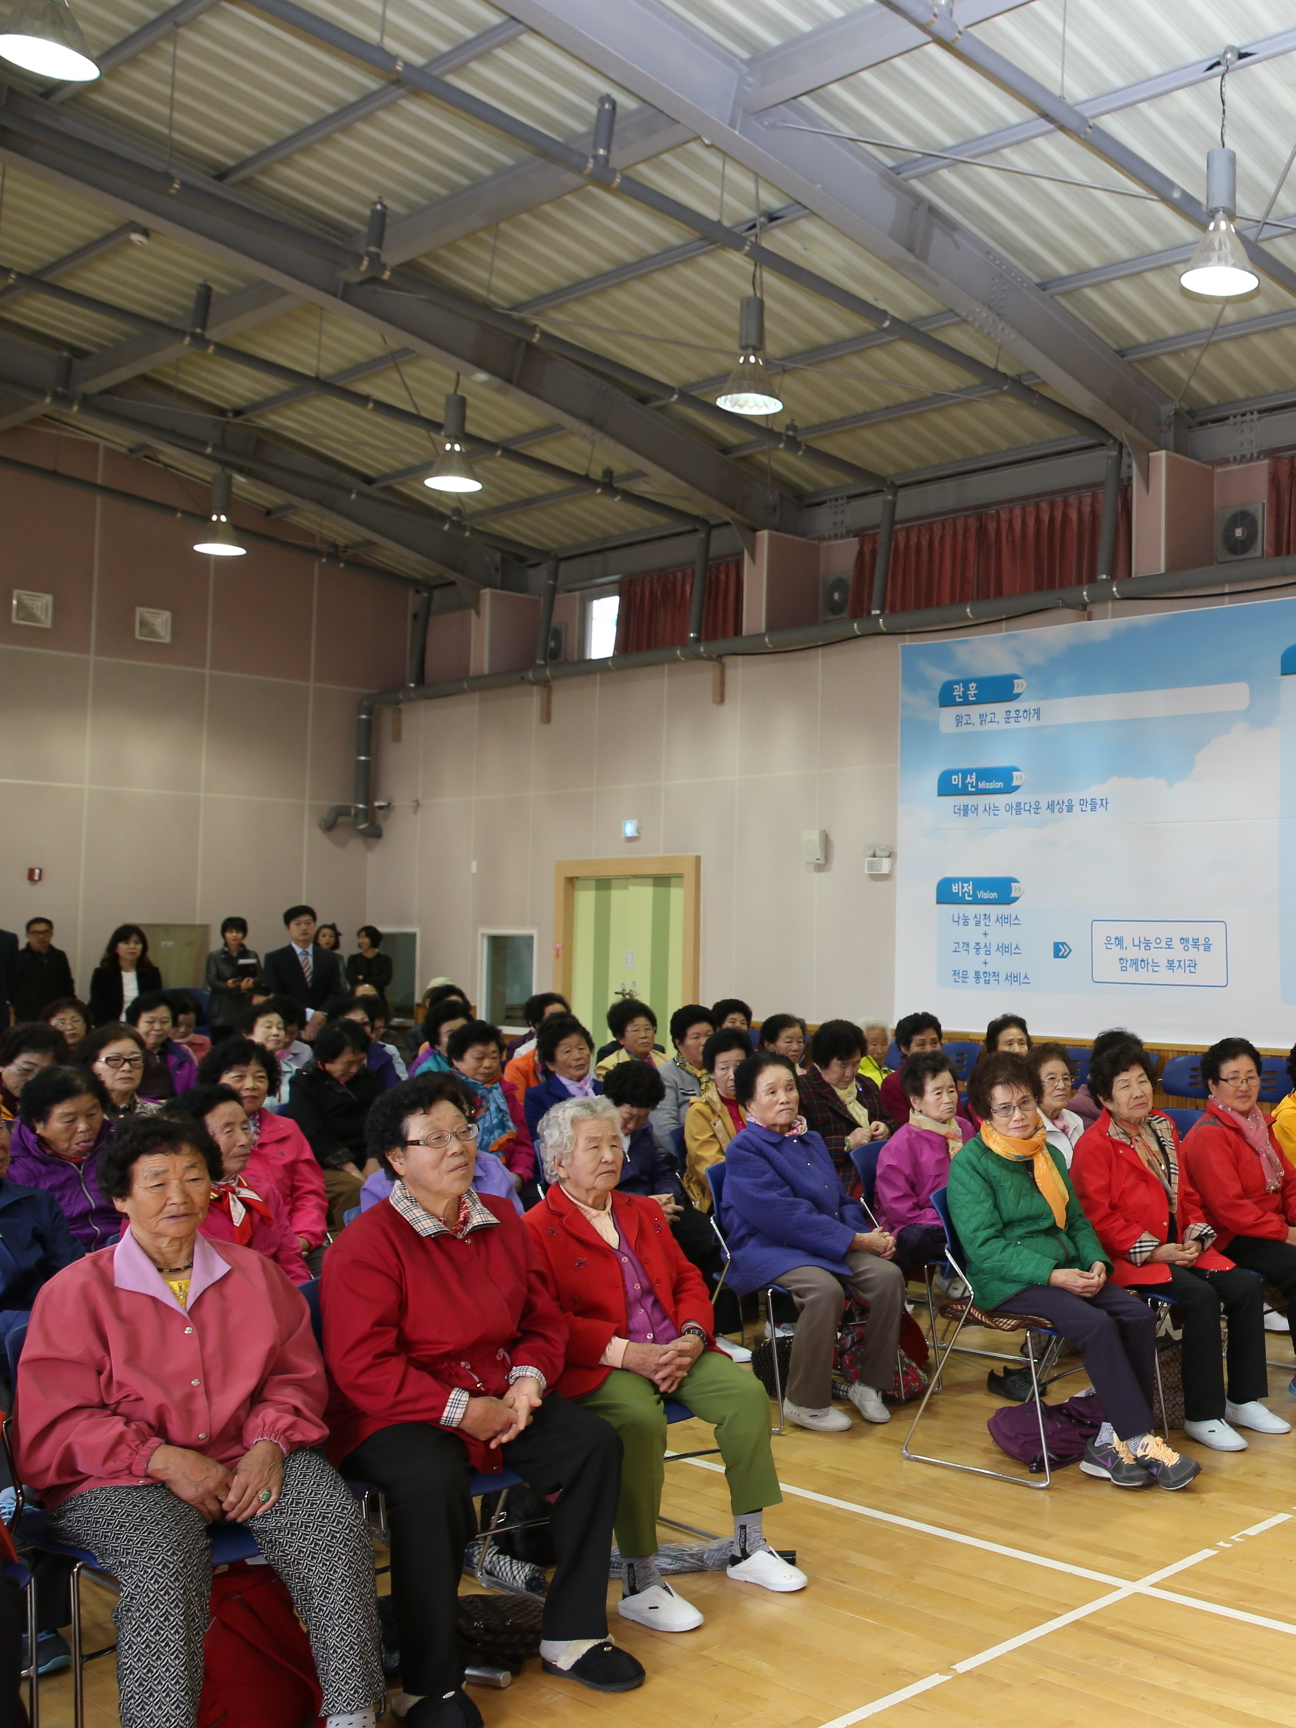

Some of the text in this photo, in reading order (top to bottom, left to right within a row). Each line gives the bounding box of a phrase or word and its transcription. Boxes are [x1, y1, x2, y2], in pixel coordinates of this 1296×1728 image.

[955, 714, 975, 727] 맑고,
[1004, 708, 1041, 724] 훈훈하게
[978, 780, 1003, 790] Mission
[953, 798, 1109, 817] 더불어 사는 아름다운 세상을 만들자
[952, 880, 998, 900] 비전 Vision
[952, 913, 1021, 927] 나눔 실천 서비스
[952, 942, 1022, 956] 고객 중심 서비스
[1104, 937, 1213, 952] 은혜, 나눔으로 행복을
[1118, 958, 1198, 974] 함께하는 복지관
[952, 970, 1031, 985] 전문 통합적 서비스
